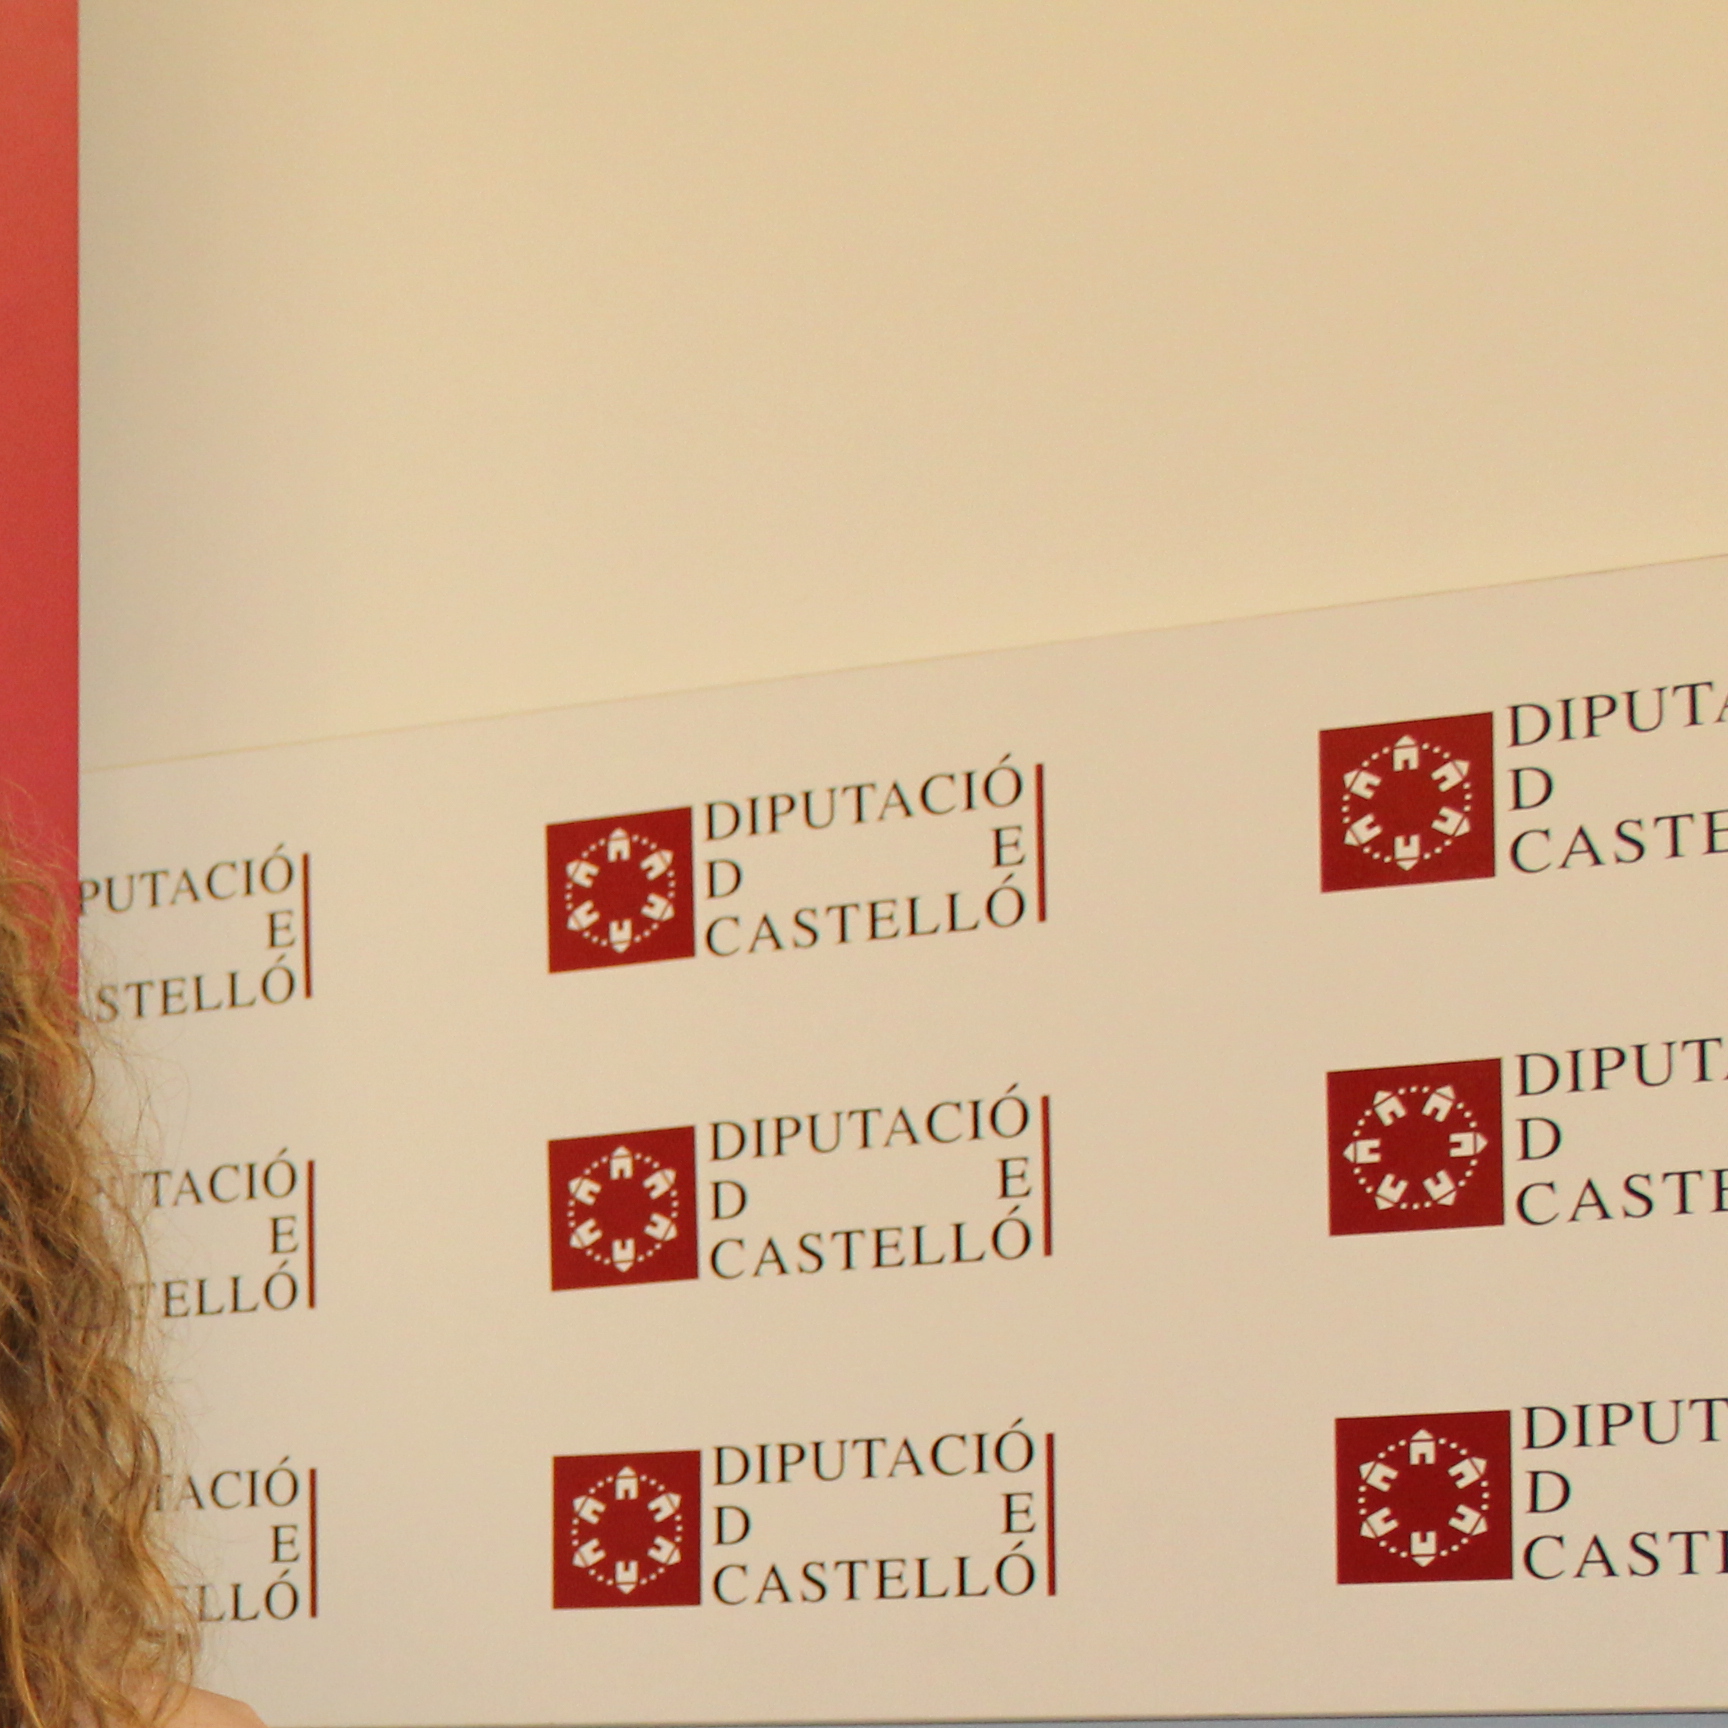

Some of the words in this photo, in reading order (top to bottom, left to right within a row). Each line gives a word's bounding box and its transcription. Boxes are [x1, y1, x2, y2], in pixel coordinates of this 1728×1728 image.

[705, 753, 1023, 842] DIPUTACIÓ
[1508, 766, 1554, 812] D
[706, 859, 743, 900] D
[991, 825, 1026, 868] E
[268, 909, 295, 949] E
[704, 873, 1026, 958] CASTELLÓ
[1515, 1037, 1728, 1097] DIPUT
[709, 1083, 1030, 1162] DIPUTACIÓ
[1516, 1117, 1562, 1162] D
[132, 1147, 297, 1209] TACIÓ
[711, 1180, 748, 1221] D
[998, 1156, 1032, 1200] E
[270, 1215, 298, 1255] E
[709, 1204, 1032, 1280] CASTELLÓ
[713, 1416, 1035, 1486] DIPUTACIÓ
[1521, 1397, 1728, 1450] DIPUT
[713, 1505, 751, 1546] D
[1001, 1491, 1036, 1535] E
[1525, 1469, 1571, 1514] D
[271, 1524, 300, 1564] E
[712, 1541, 1036, 1606] CASTELLÓ
